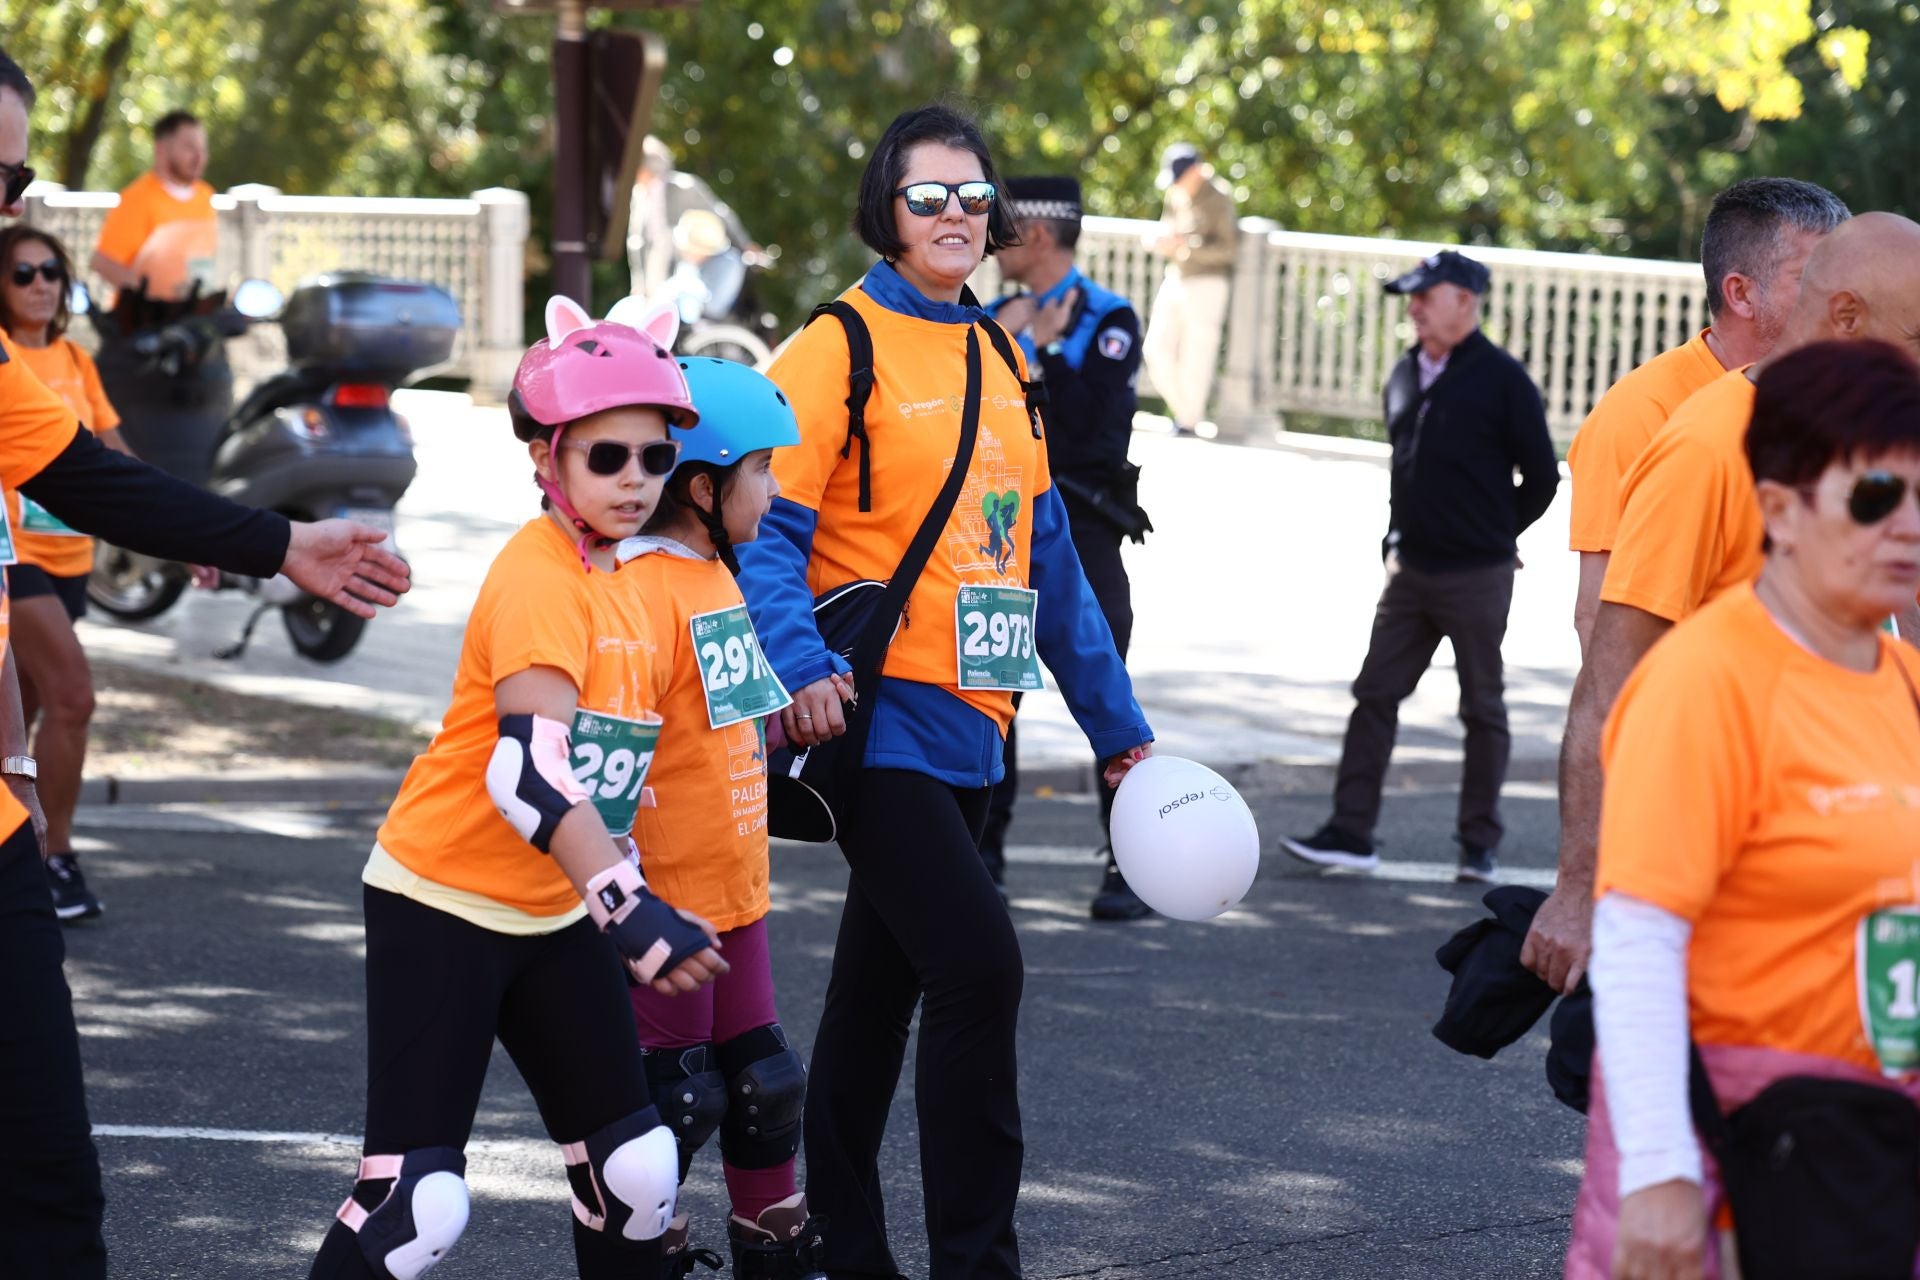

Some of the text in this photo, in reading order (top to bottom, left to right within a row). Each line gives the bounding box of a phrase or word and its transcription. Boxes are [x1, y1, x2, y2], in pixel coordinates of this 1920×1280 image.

[963, 610, 1032, 660] 2973
[1158, 791, 1205, 820] repsol
[738, 822, 751, 836] EL
